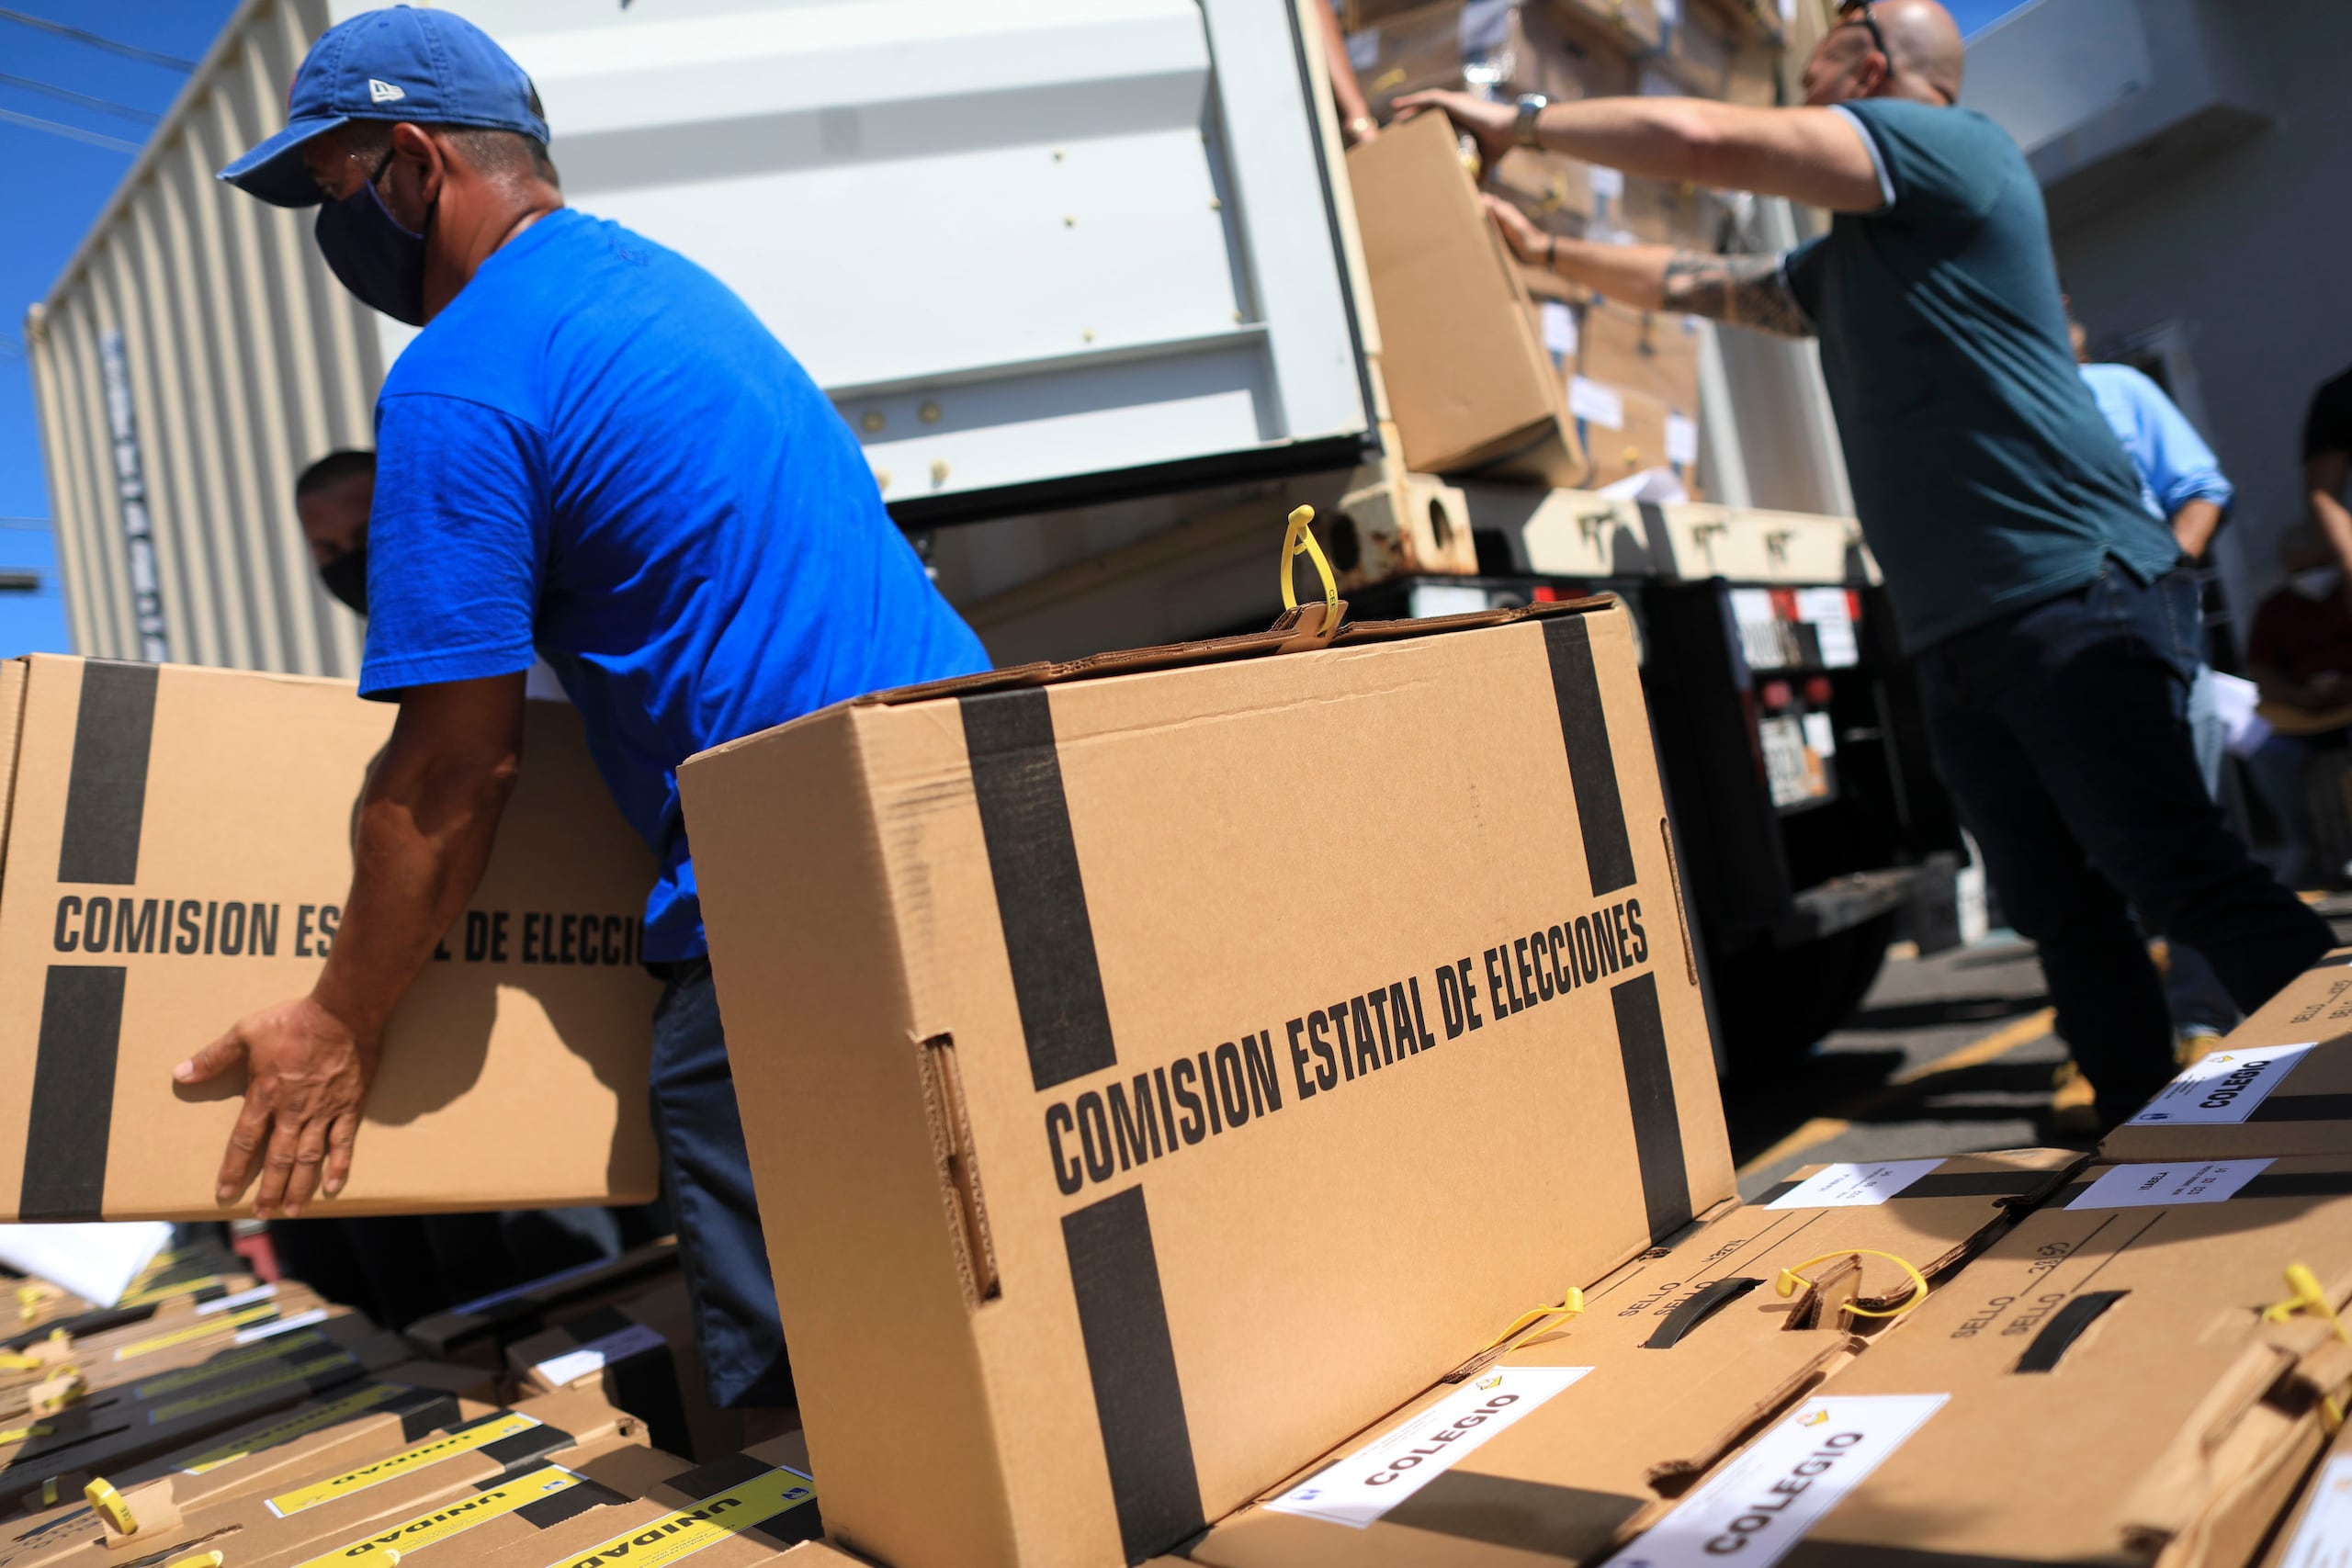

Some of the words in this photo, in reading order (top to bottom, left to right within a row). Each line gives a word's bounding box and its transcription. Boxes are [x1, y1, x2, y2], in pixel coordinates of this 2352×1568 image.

[53, 896, 280, 957] COMISION
[465, 910, 510, 962] DE
[1046, 1030, 1283, 1196] COMISION
[1285, 976, 1436, 1100] ESTATAL
[1436, 957, 1483, 1040] DE
[1484, 898, 1649, 1021] ELECCIONES
[2199, 1060, 2272, 1109] COLEGIO
[1618, 1282, 1681, 1317] SELLO
[1950, 1296, 2016, 1338] SELLO
[2001, 1293, 2066, 1336] SELLO
[332, 1435, 471, 1485] UNIDAD
[1363, 1394, 1521, 1486] COLEGIO
[1702, 1432, 1864, 1555] COLEGIO
[345, 1492, 508, 1558] UNIDAD
